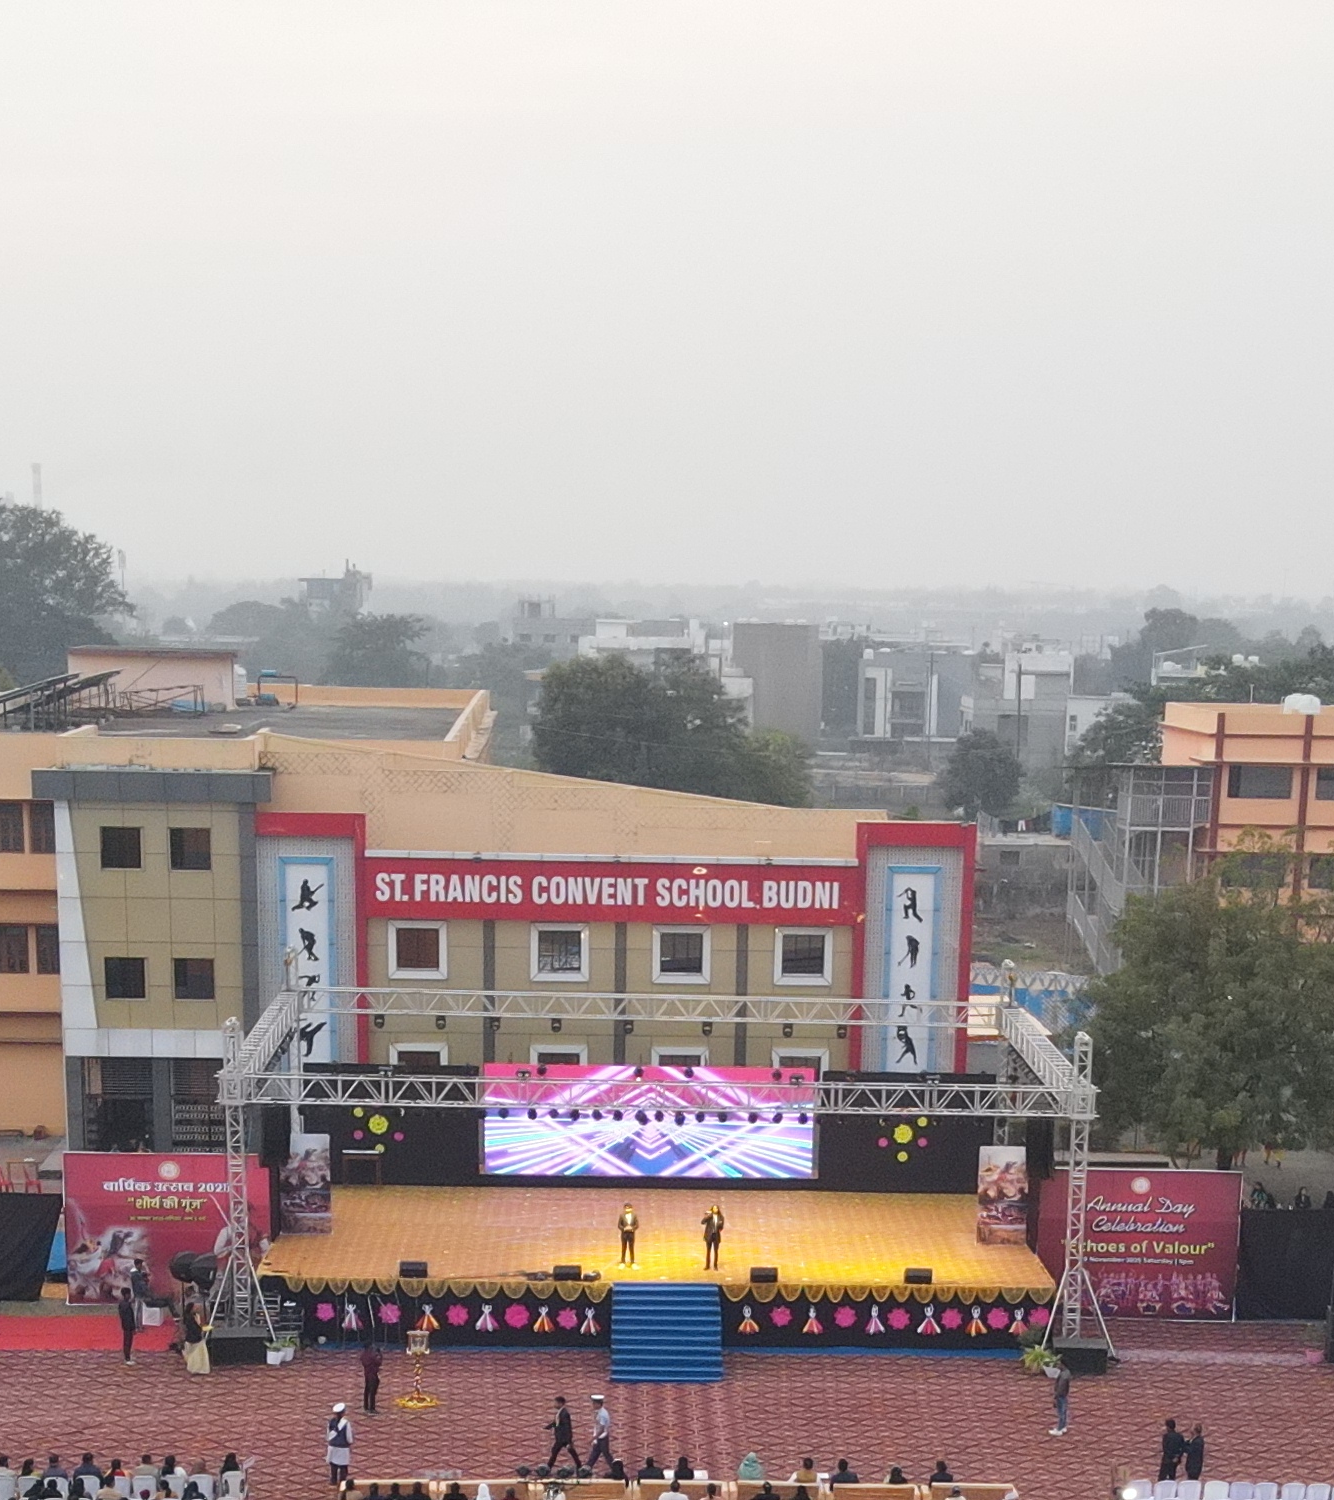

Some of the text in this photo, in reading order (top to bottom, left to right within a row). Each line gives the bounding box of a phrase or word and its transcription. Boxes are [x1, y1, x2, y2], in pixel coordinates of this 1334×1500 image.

[375, 872, 408, 902] ST.
[414, 873, 523, 904] FRANCIS
[532, 876, 649, 907] CONVENT
[762, 880, 839, 910] BUDNI
[102, 1178, 151, 1192] वार्षिक
[1086, 1195, 1196, 1218] Annual Day
[1091, 1215, 1186, 1234] Celebration
[1130, 1240, 1148, 1253] of
